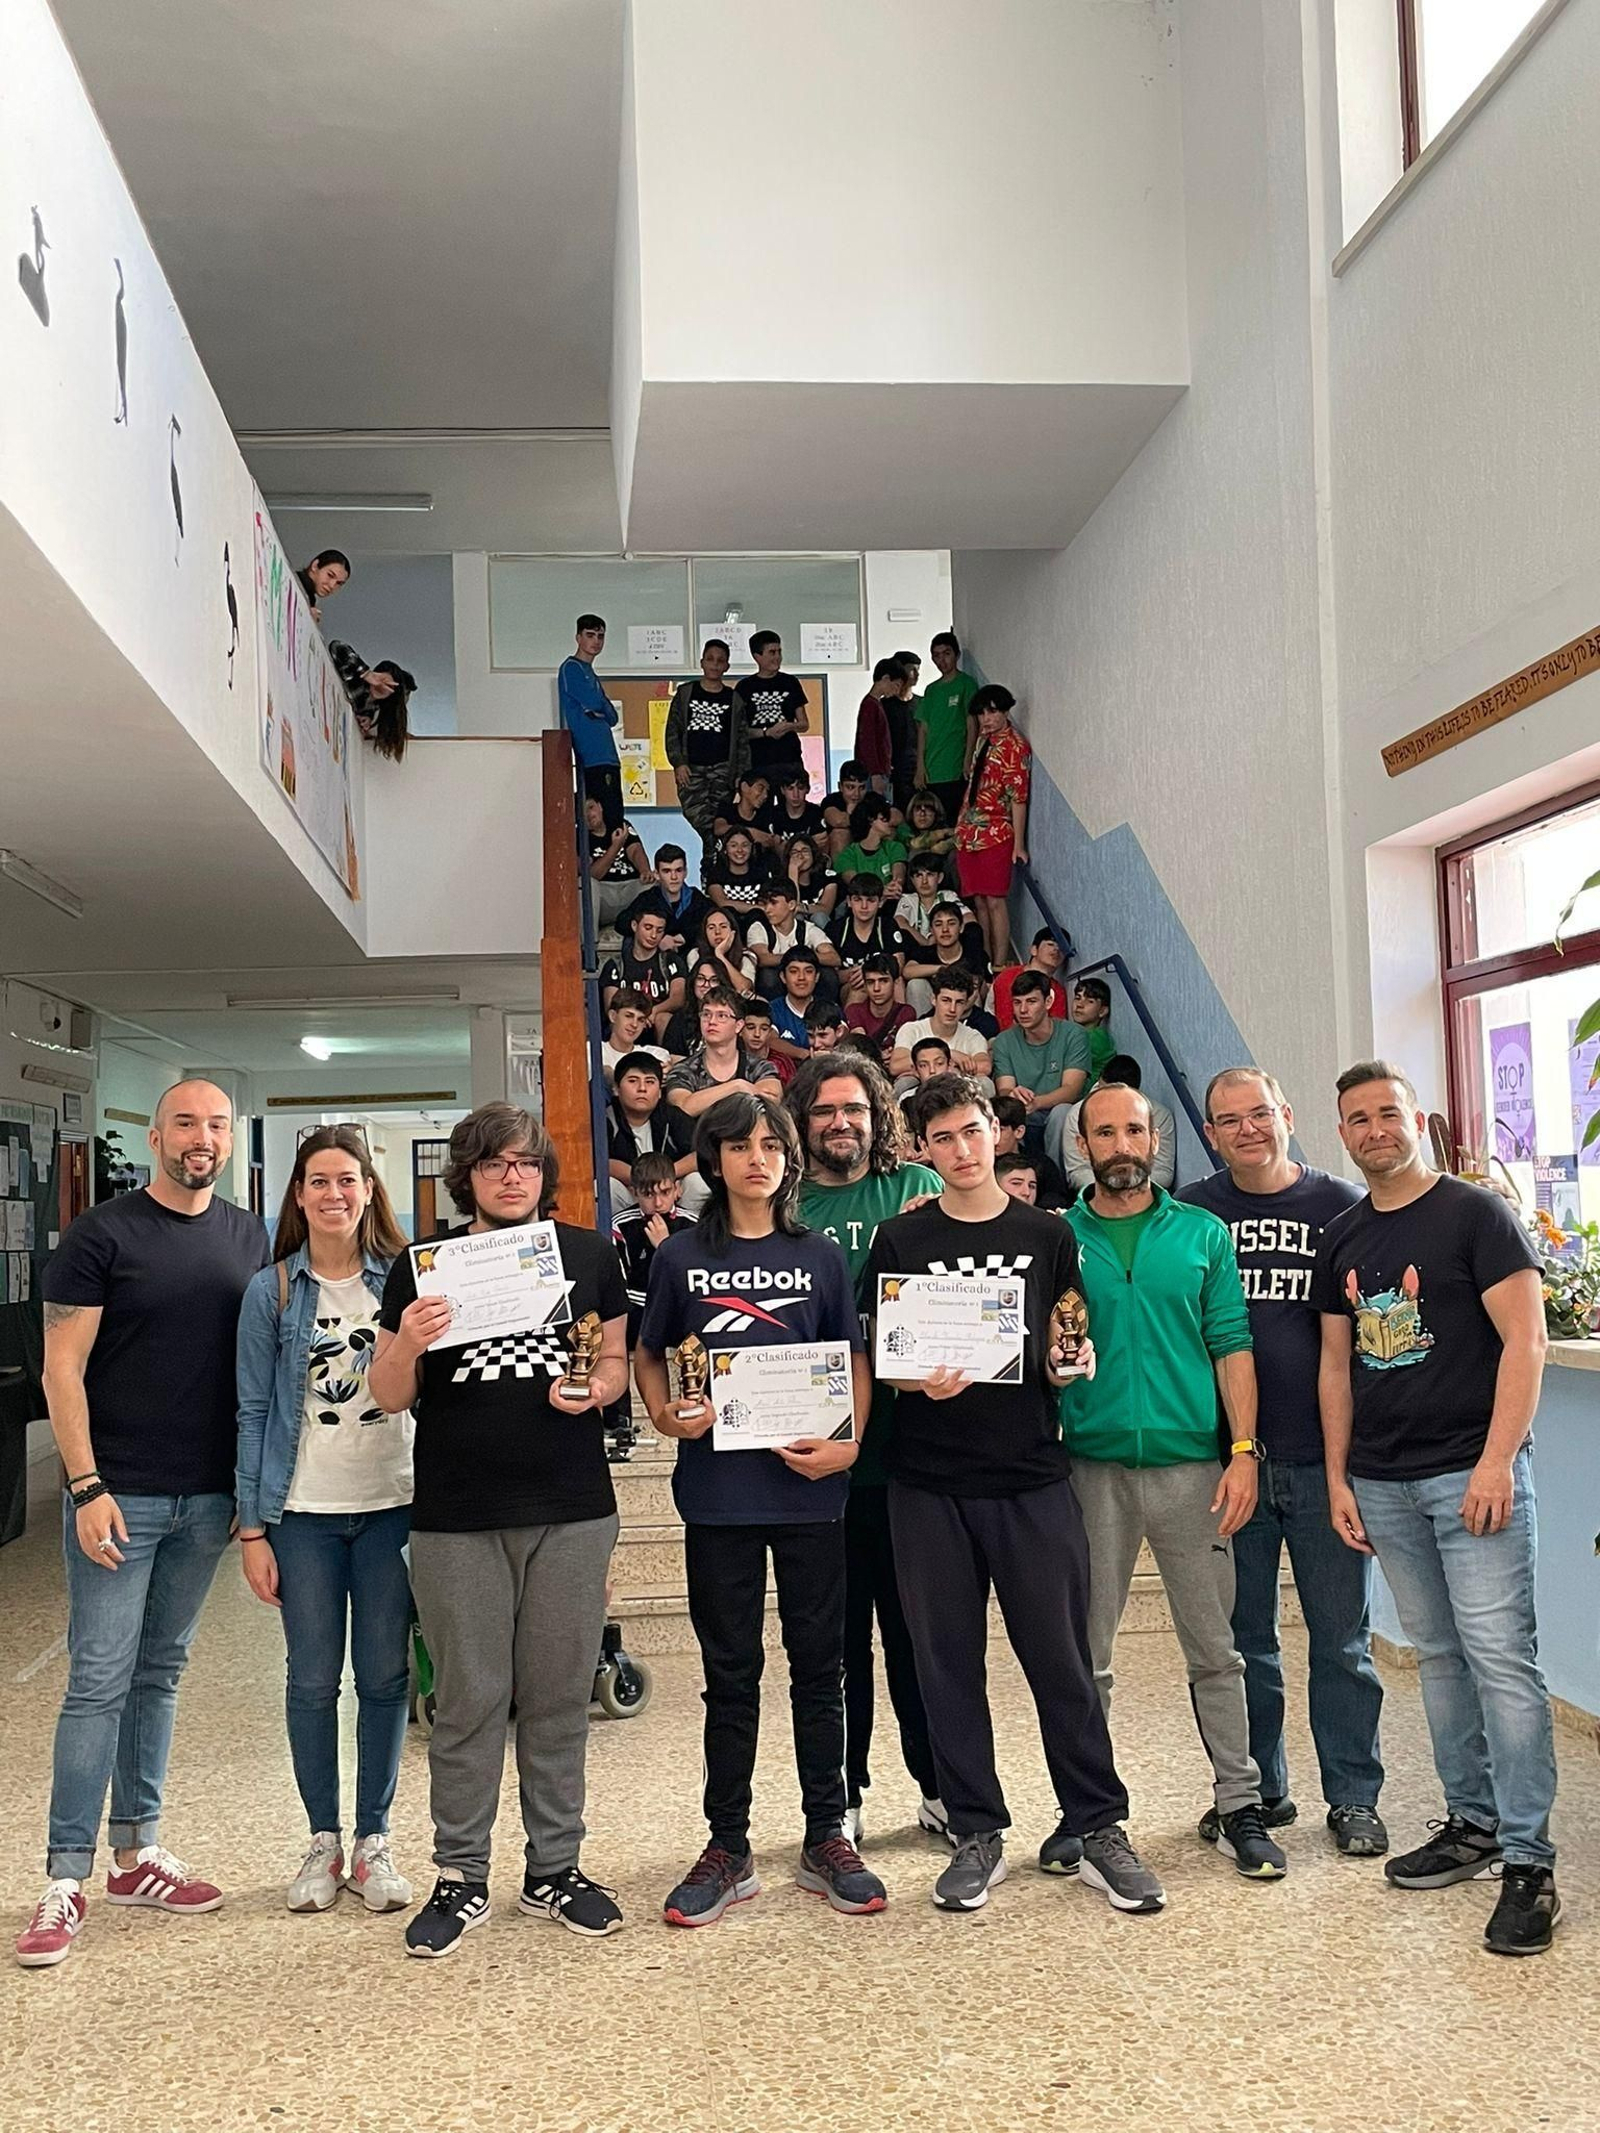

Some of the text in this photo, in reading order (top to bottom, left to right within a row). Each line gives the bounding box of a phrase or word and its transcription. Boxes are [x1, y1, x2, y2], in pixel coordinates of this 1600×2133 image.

[1480, 697, 1496, 718] BE
[1548, 651, 1578, 676] ONLY
[1574, 644, 1587, 664] TO
[1498, 1062, 1525, 1090] STOP
[1533, 1155, 1551, 1169] STOP
[1535, 1167, 1567, 1182] VIOLENCE
[687, 1265, 813, 1296] Reebok
